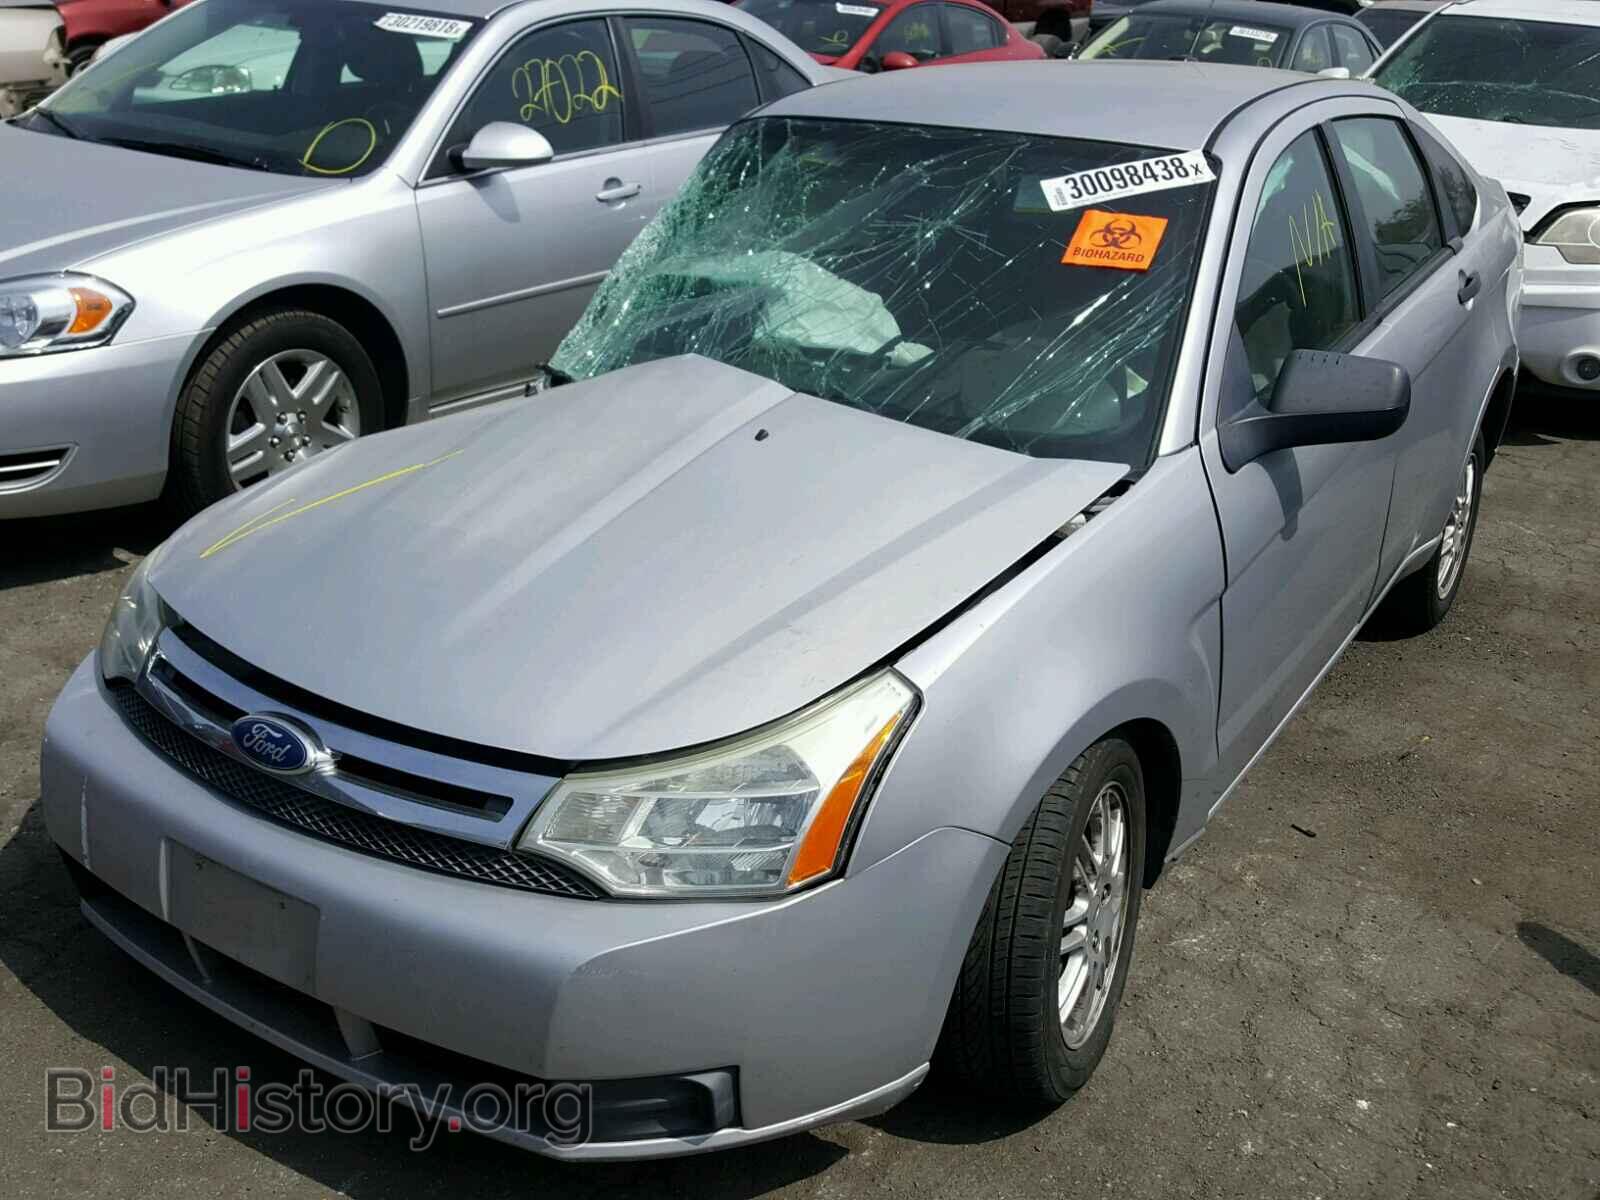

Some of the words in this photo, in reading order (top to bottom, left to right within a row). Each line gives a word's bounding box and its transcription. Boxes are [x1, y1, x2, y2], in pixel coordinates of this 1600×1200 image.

[1065, 157, 1189, 199] 30098438
[1072, 247, 1145, 263] BIOHAZARD
[242, 723, 292, 762] Ford
